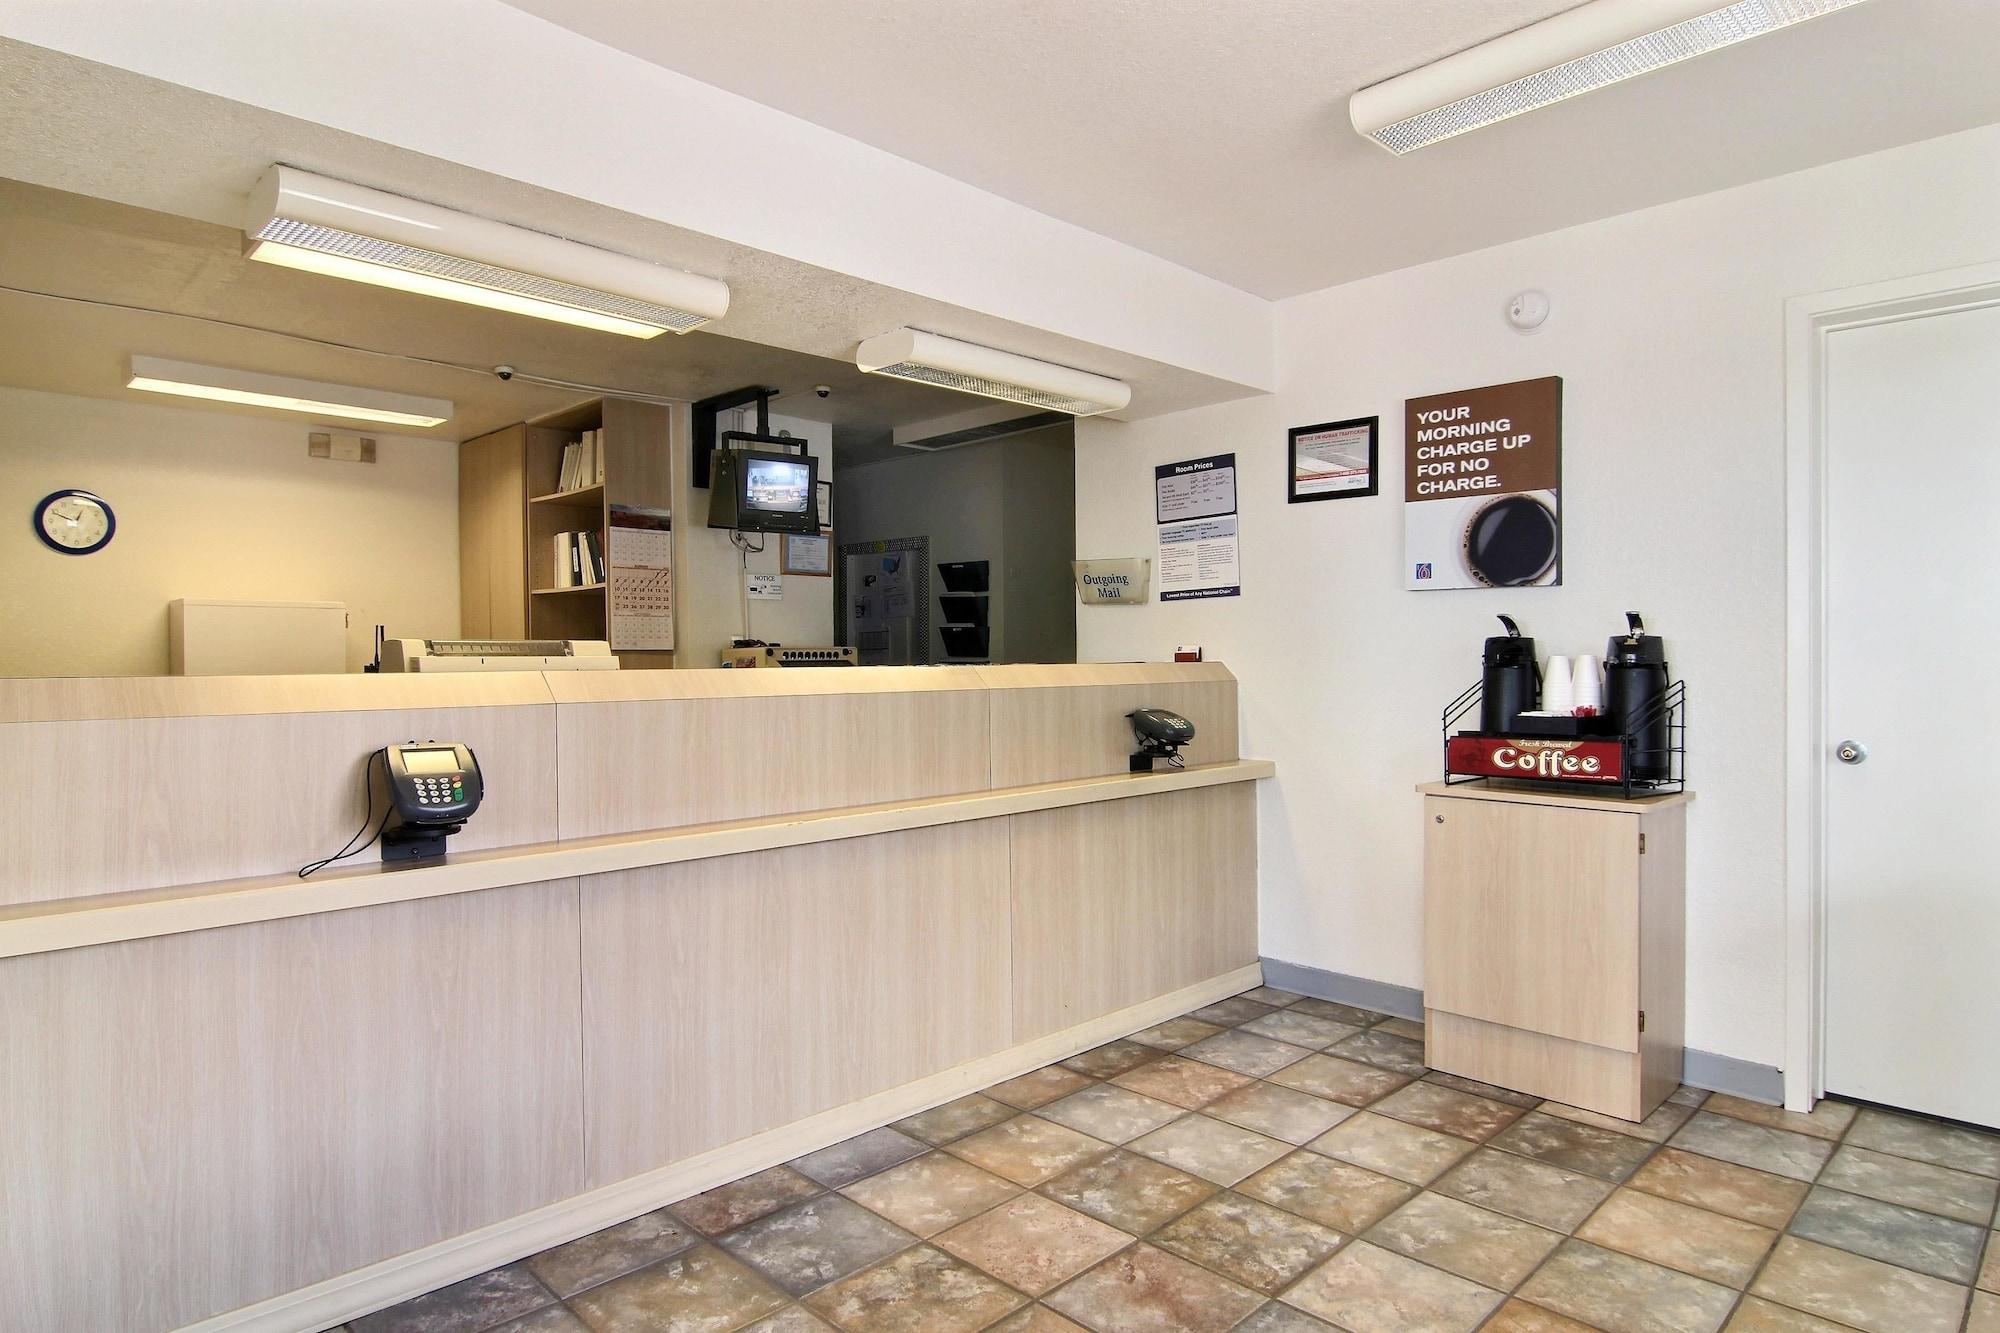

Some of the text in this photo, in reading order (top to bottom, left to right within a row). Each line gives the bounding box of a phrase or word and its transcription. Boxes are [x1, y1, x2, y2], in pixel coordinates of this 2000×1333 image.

[1416, 406, 1470, 424] YOUR
[1339, 428, 1368, 437] TRAFFICKING
[1417, 418, 1511, 442] MORNING
[1416, 434, 1532, 460] CHARGE UP
[1176, 462, 1214, 473] Room Prices
[1417, 458, 1490, 477] FOR NO
[1416, 475, 1502, 494] CHARGE.
[1083, 574, 1130, 586] Outgoing
[1098, 588, 1120, 598] Mail
[1492, 748, 1600, 776] Coffee
